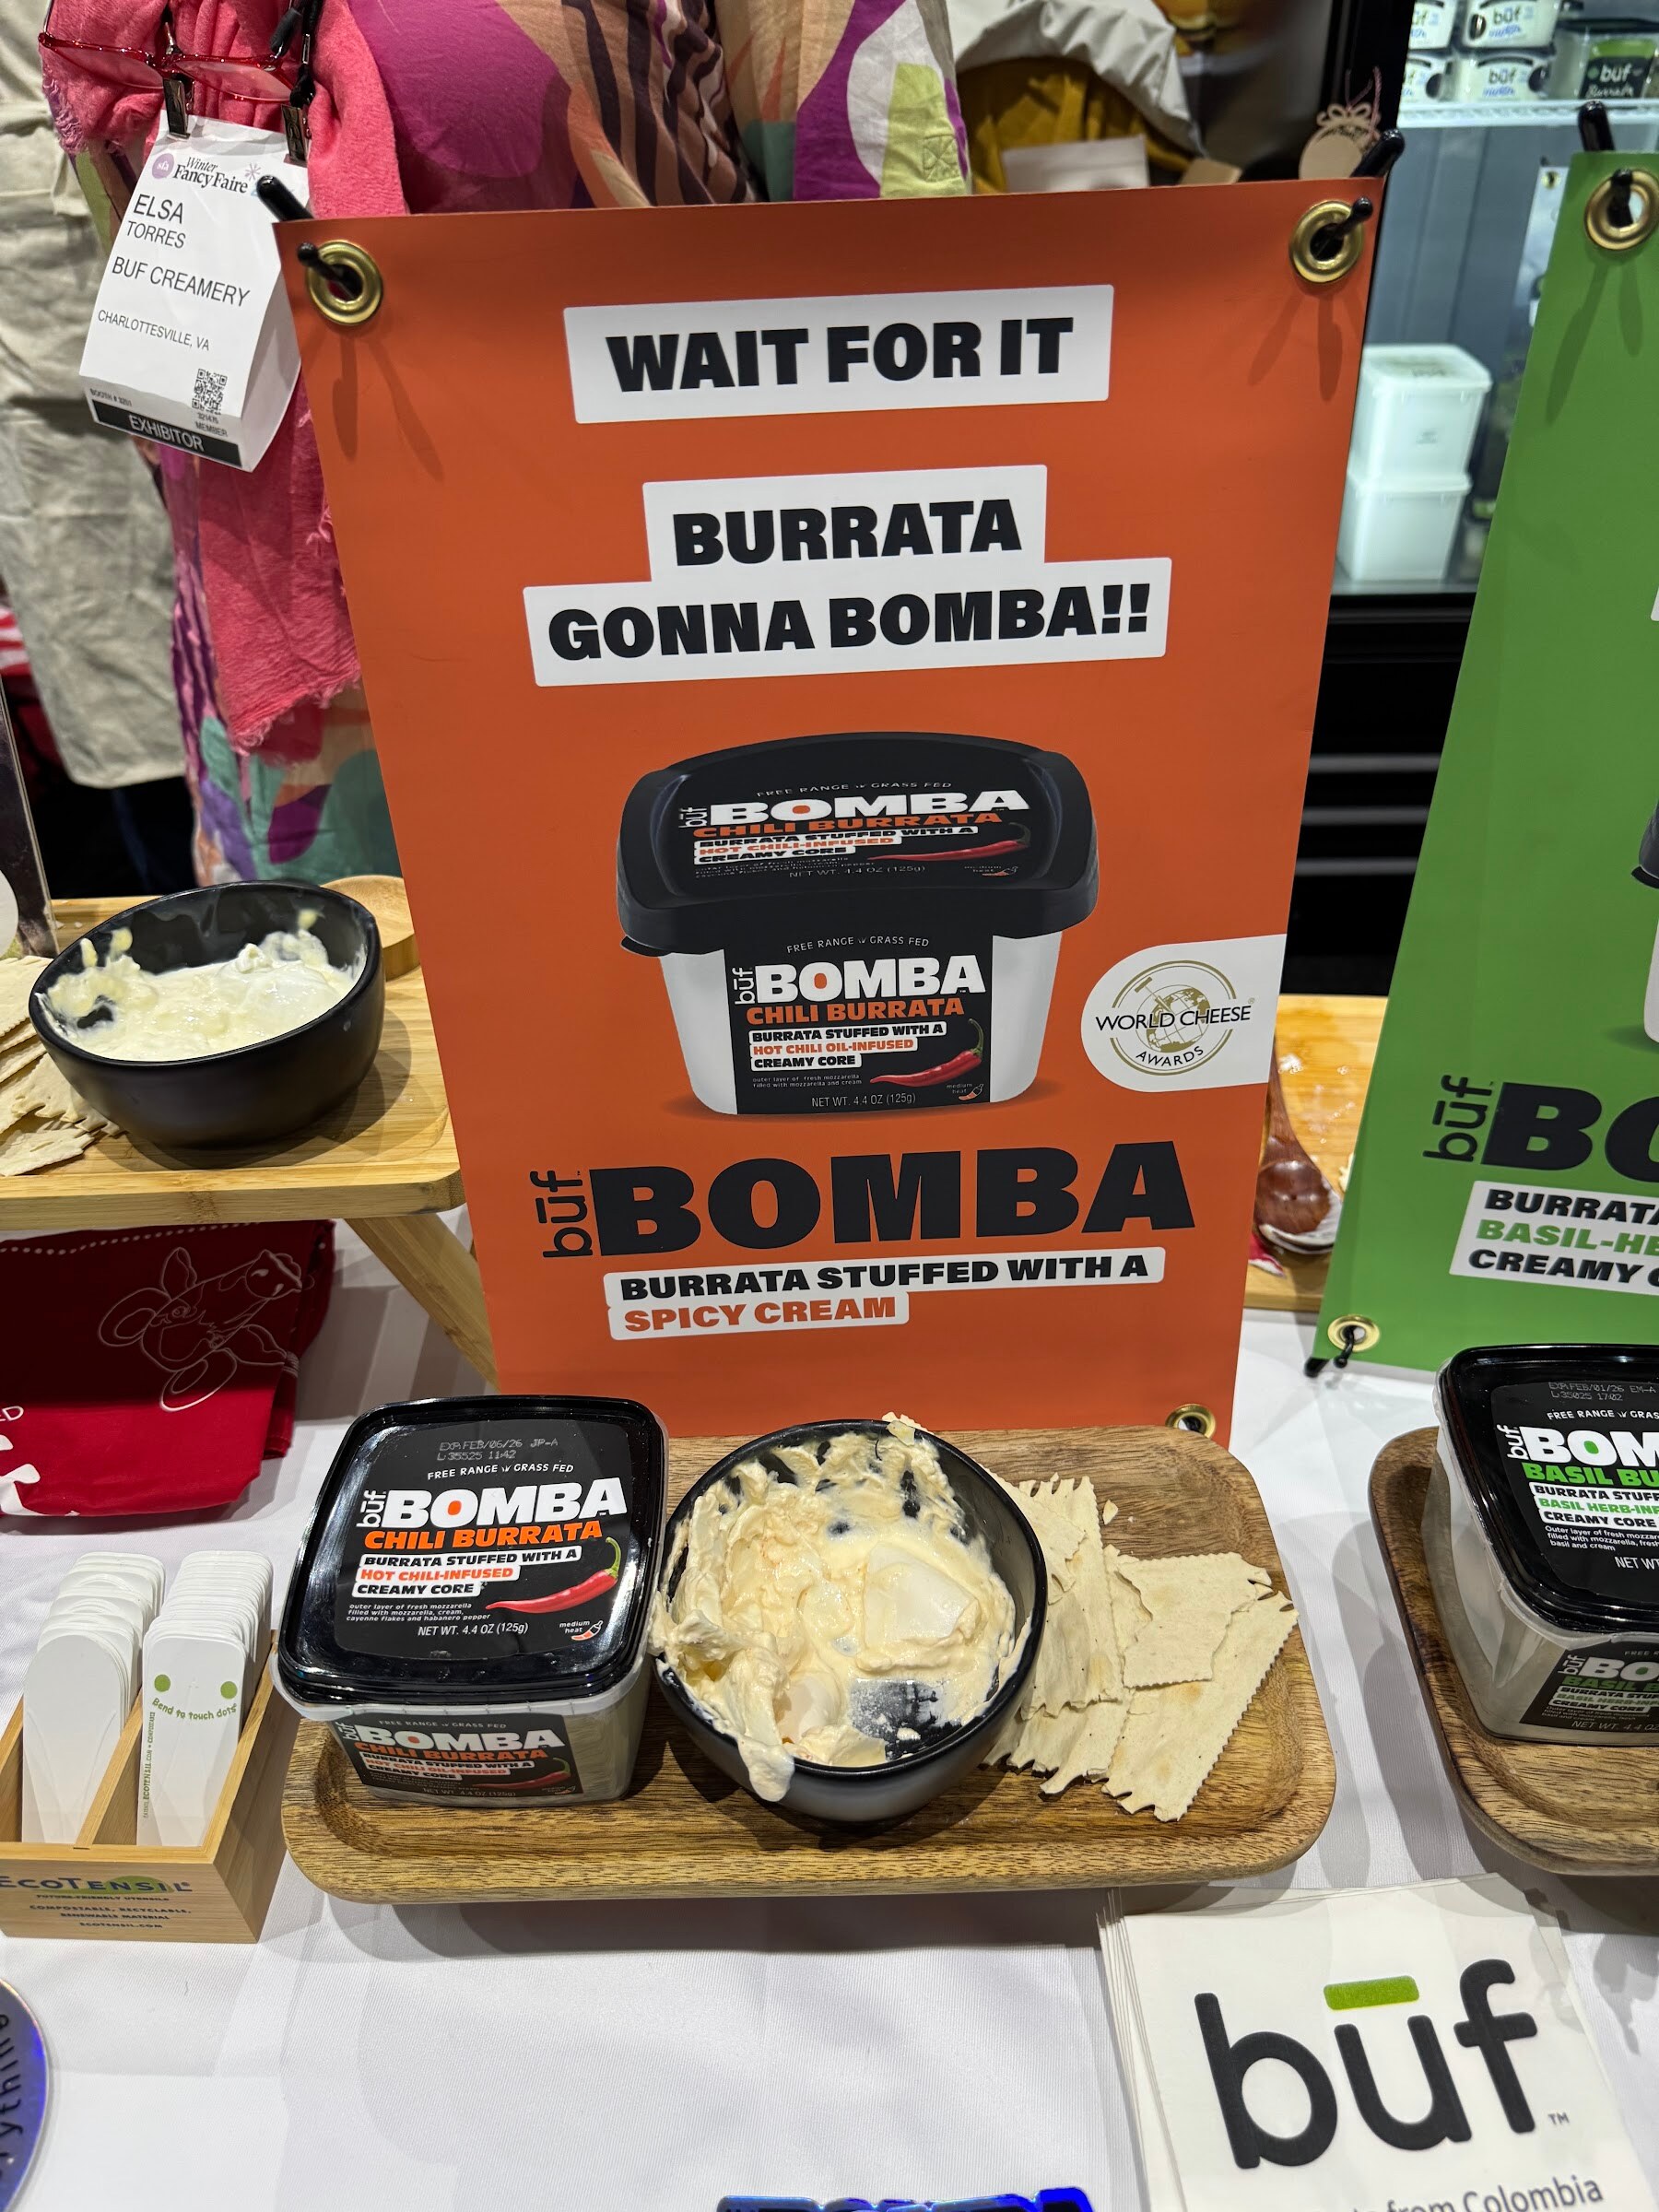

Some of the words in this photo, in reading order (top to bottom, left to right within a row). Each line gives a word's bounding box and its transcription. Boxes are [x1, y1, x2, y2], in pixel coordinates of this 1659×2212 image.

[186, 157, 218, 173] Winter
[133, 194, 184, 225] ELSA
[126, 220, 186, 249] TORRES
[112, 256, 148, 279] BUF
[150, 265, 251, 307] CREAMERY
[98, 309, 194, 347] CHARLOTTESVILLE,
[196, 335, 210, 351] VA
[606, 328, 809, 393] WAIT
[827, 320, 982, 383] FOR
[999, 317, 1074, 376] IT
[129, 414, 205, 453] EXHIBITOR
[194, 421, 229, 437] MEMBER
[672, 499, 1022, 567] BURRATA
[548, 599, 816, 661] GONNA
[829, 582, 1150, 649] BOMBA!!
[799, 783, 849, 794] RANGE
[711, 790, 1030, 826] BOMBA
[693, 822, 796, 838] CHILI
[808, 812, 1003, 831] BURRATA
[700, 835, 800, 847] BURRATA
[806, 830, 896, 841] STUFFED
[900, 828, 953, 837] WITH
[700, 846, 742, 856] HOT
[747, 837, 894, 852] CHILI-INFUSED
[699, 851, 792, 864] CREAMY
[792, 847, 847, 856] CORE
[787, 940, 815, 955] FREE
[818, 936, 855, 949] RANGE
[869, 935, 905, 946] GRASS
[908, 936, 930, 948] FED
[732, 967, 756, 1006] būf
[755, 955, 987, 1005] BOMBA
[747, 1003, 819, 1026] CHILI
[826, 997, 965, 1022] BURRATA
[1095, 1013, 1175, 1031] WORLD
[1180, 1006, 1252, 1027] CHEESE
[752, 1030, 823, 1043] BURRATA
[825, 1026, 889, 1041] STUFFED
[892, 1024, 929, 1036] WITH
[932, 1024, 944, 1034] A
[753, 1045, 782, 1056] HOT
[785, 1043, 823, 1054] CHILI
[825, 1039, 914, 1053] OIL-INFUSED
[1135, 1045, 1204, 1067] AWARDS
[754, 1056, 815, 1069] CREAMY
[818, 1055, 856, 1066] CORE
[811, 1096, 830, 1108] NET
[831, 1095, 851, 1107] WT.
[853, 1095, 867, 1106] 4.4
[870, 1094, 883, 1105] OZ
[886, 1092, 916, 1106] (125g)
[1422, 1075, 1493, 1162] būf
[589, 1141, 1196, 1257] BOMBA
[528, 1169, 593, 1259] būf
[1468, 1249, 1644, 1284] CREAMY
[620, 1270, 811, 1301] BURRATA
[817, 1260, 999, 1290] STUFFED
[1008, 1255, 1113, 1282] WITH
[1120, 1254, 1148, 1277] A
[624, 1304, 748, 1332] SPICY
[755, 1298, 896, 1324] CREAM
[1547, 1410, 1575, 1420] FREE
[1577, 1409, 1615, 1418] RANGE
[427, 1468, 456, 1481] FREE
[461, 1465, 499, 1477] RANGE
[513, 1464, 549, 1472] GRASS
[553, 1464, 574, 1473] FED
[1522, 1462, 1614, 1486] BASIL
[1534, 1484, 1610, 1500] BURRATA
[356, 1489, 387, 1527] būf
[381, 1477, 628, 1528] BOMBA
[1538, 1498, 1585, 1511] BASIL
[1543, 1511, 1609, 1524] CREAMY
[1613, 1517, 1657, 1528] CORE
[364, 1530, 445, 1549] CHILI
[452, 1521, 603, 1548] BURRATA
[1545, 1525, 1569, 1534] Outer
[1570, 1527, 1591, 1536] layer
[1604, 1530, 1625, 1538] fresh
[1550, 1539, 1570, 1547] basil
[1590, 1543, 1616, 1551] cream
[1590, 1536, 1639, 1547] mozzarella,
[365, 1556, 442, 1567] BURRATA
[447, 1553, 518, 1566] STUFFED
[522, 1550, 562, 1562] WITH
[565, 1549, 577, 1559] A
[1615, 1556, 1639, 1569] NET
[360, 1570, 395, 1581] HOT
[398, 1567, 513, 1582] CHILI-INFUSED
[357, 1583, 428, 1594] CREAMY
[429, 1583, 475, 1594] CORE
[418, 1626, 440, 1636] NET
[441, 1625, 459, 1635] WT.
[462, 1625, 477, 1635] 4.4
[480, 1624, 495, 1634] OZ
[496, 1622, 529, 1635] (125g)
[559, 1620, 591, 1629] medium
[1560, 1687, 1624, 1698] BURRATA
[1562, 1676, 1640, 1691] BASIL
[152, 1697, 174, 1715] Bend
[176, 1709, 186, 1719] to
[188, 1711, 215, 1720] touch
[1552, 1700, 1608, 1710] CREAMY
[1571, 1720, 1596, 1729] NET
[355, 1724, 565, 1751] BOMBA
[354, 1742, 415, 1758] CHILI
[424, 1749, 548, 1761] BURRATA
[362, 1753, 423, 1767] BURRATA
[369, 1765, 420, 1778] CREAMY
[1194, 1958, 1538, 2170] būf
[1463, 2175, 1604, 2212] Colombia
